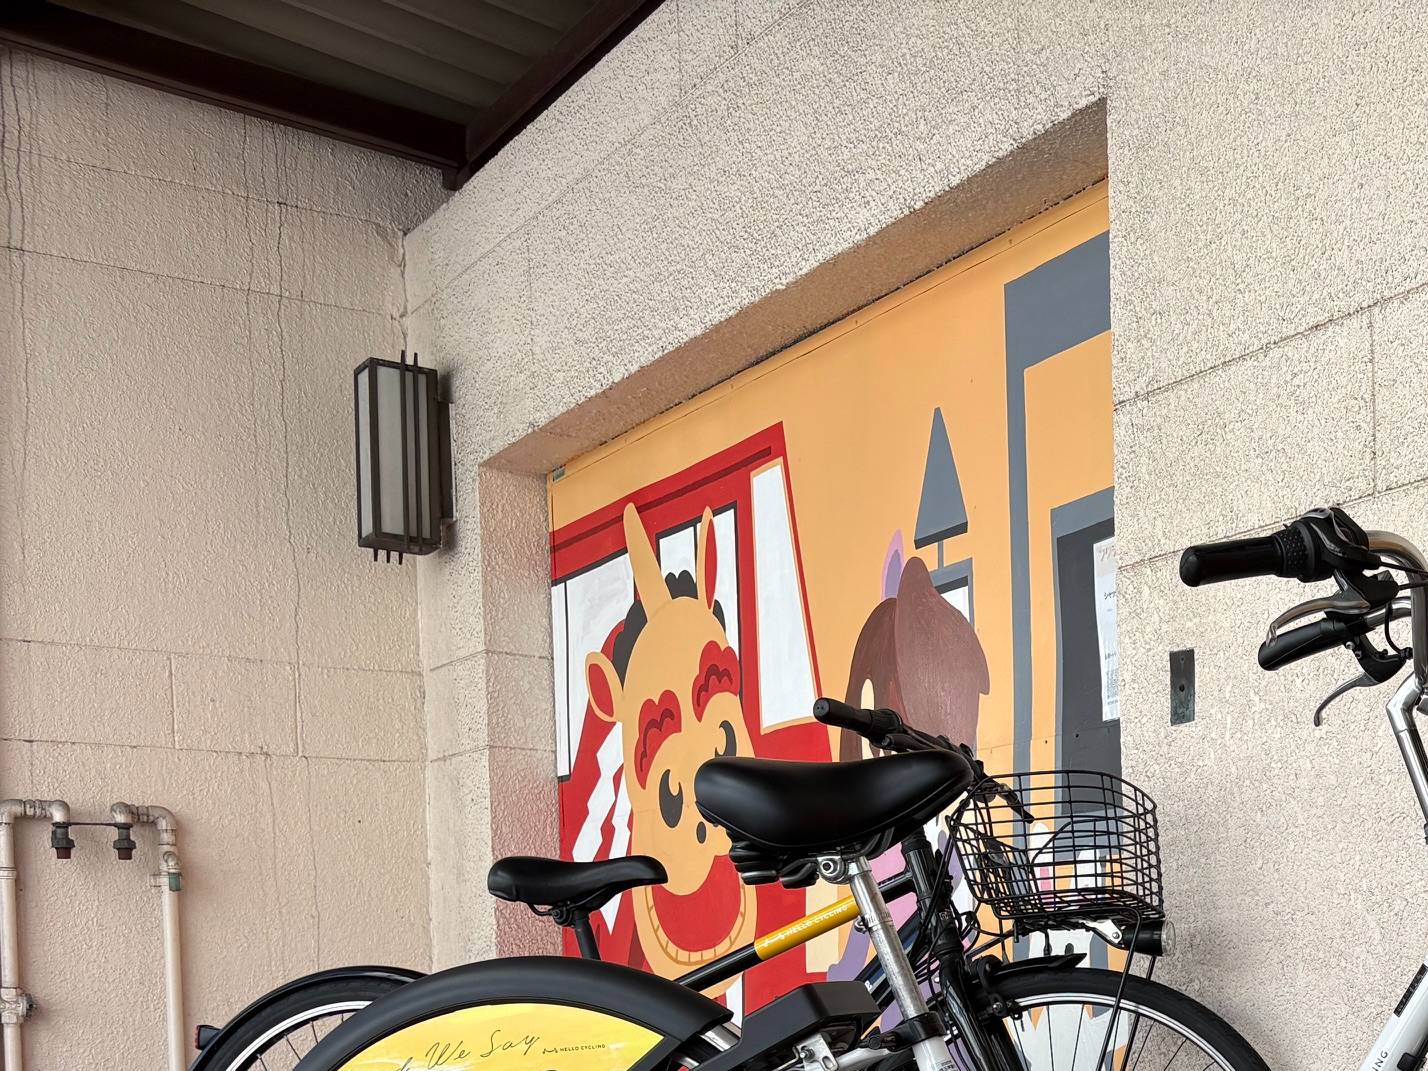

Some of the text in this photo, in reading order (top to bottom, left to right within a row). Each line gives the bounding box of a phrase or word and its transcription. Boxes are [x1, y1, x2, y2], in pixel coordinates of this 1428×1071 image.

[425, 1040, 472, 1071] We
[480, 1029, 540, 1058] Say
[580, 1043, 606, 1051] CYCLING
